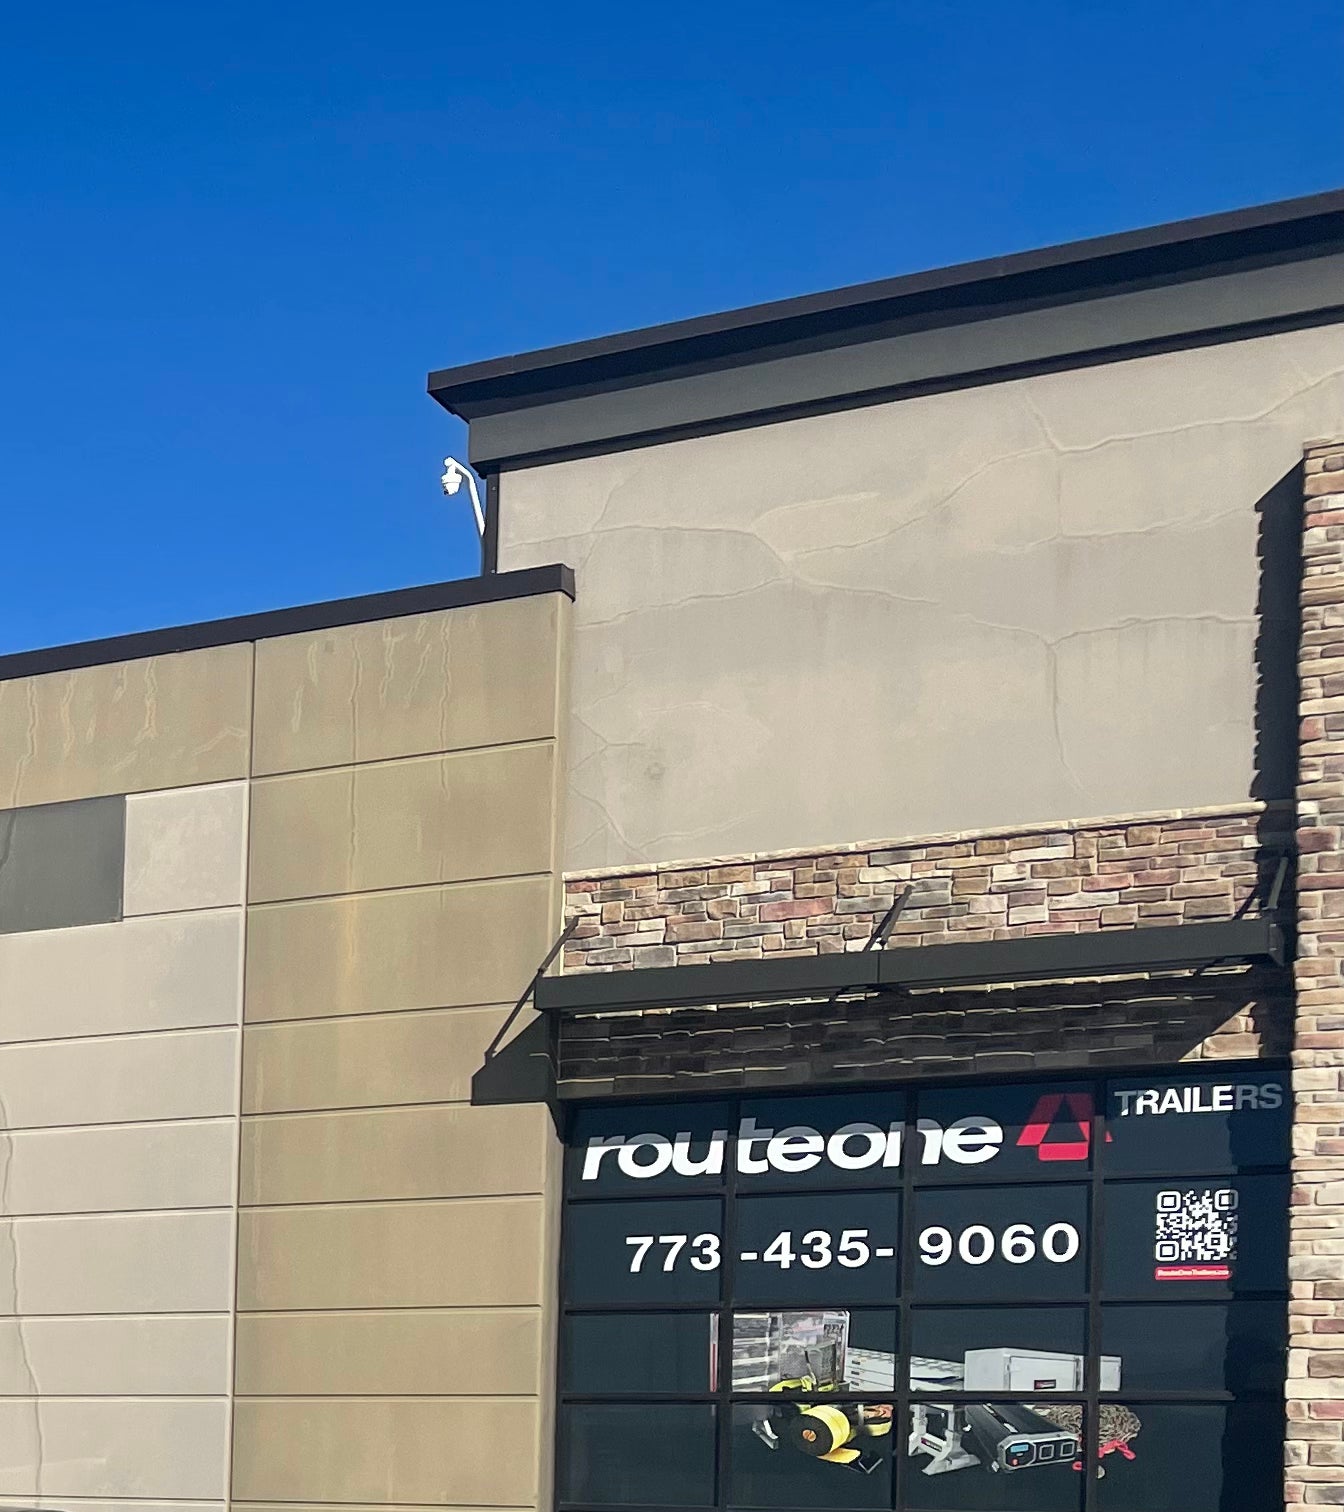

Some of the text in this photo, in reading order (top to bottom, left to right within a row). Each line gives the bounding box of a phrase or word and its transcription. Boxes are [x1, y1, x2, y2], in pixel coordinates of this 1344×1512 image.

[1113, 1083, 1283, 1116] TRAILERS
[581, 1116, 1004, 1180] routeone
[919, 1222, 1080, 1266] 9060
